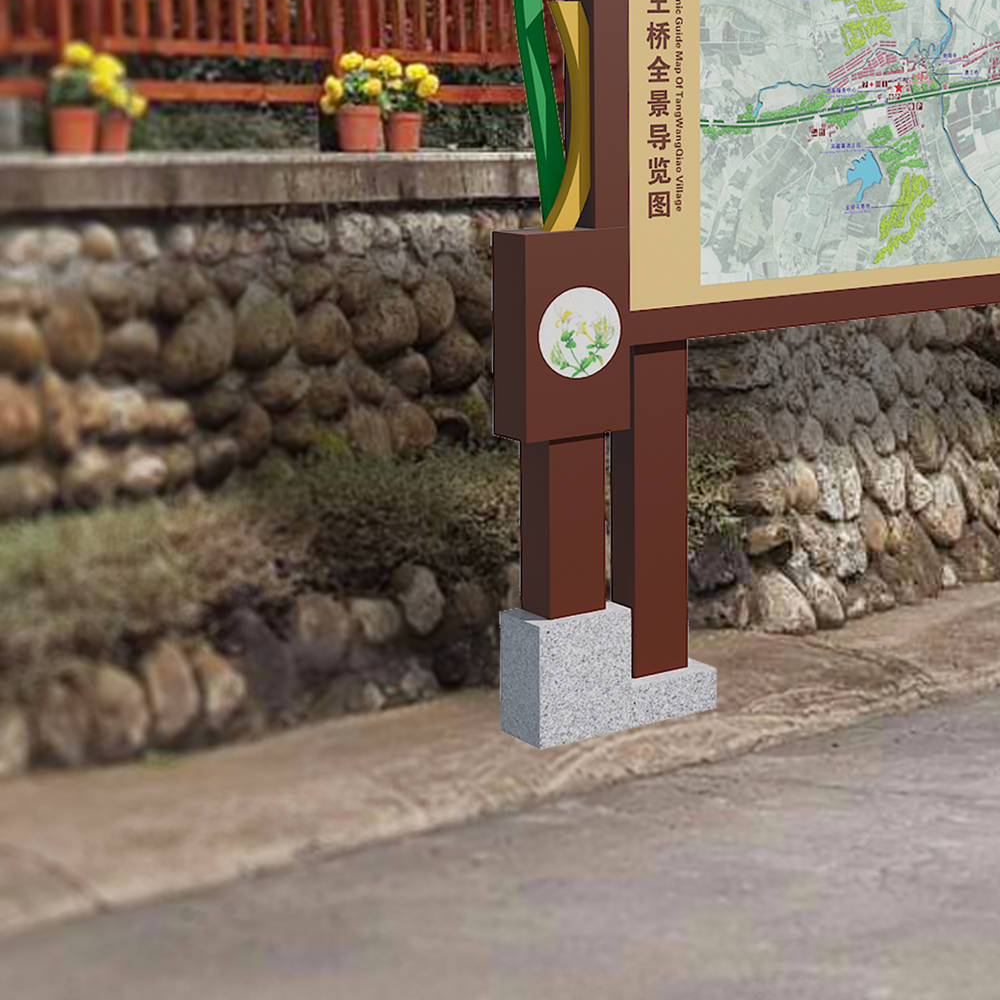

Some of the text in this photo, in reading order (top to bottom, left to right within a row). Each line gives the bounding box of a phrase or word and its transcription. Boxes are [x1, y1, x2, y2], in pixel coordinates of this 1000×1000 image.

[675, 16, 684, 48] Guide
[674, 50, 684, 73] Map
[674, 91, 684, 172] TangWangQiao
[674, 175, 684, 212] Village
